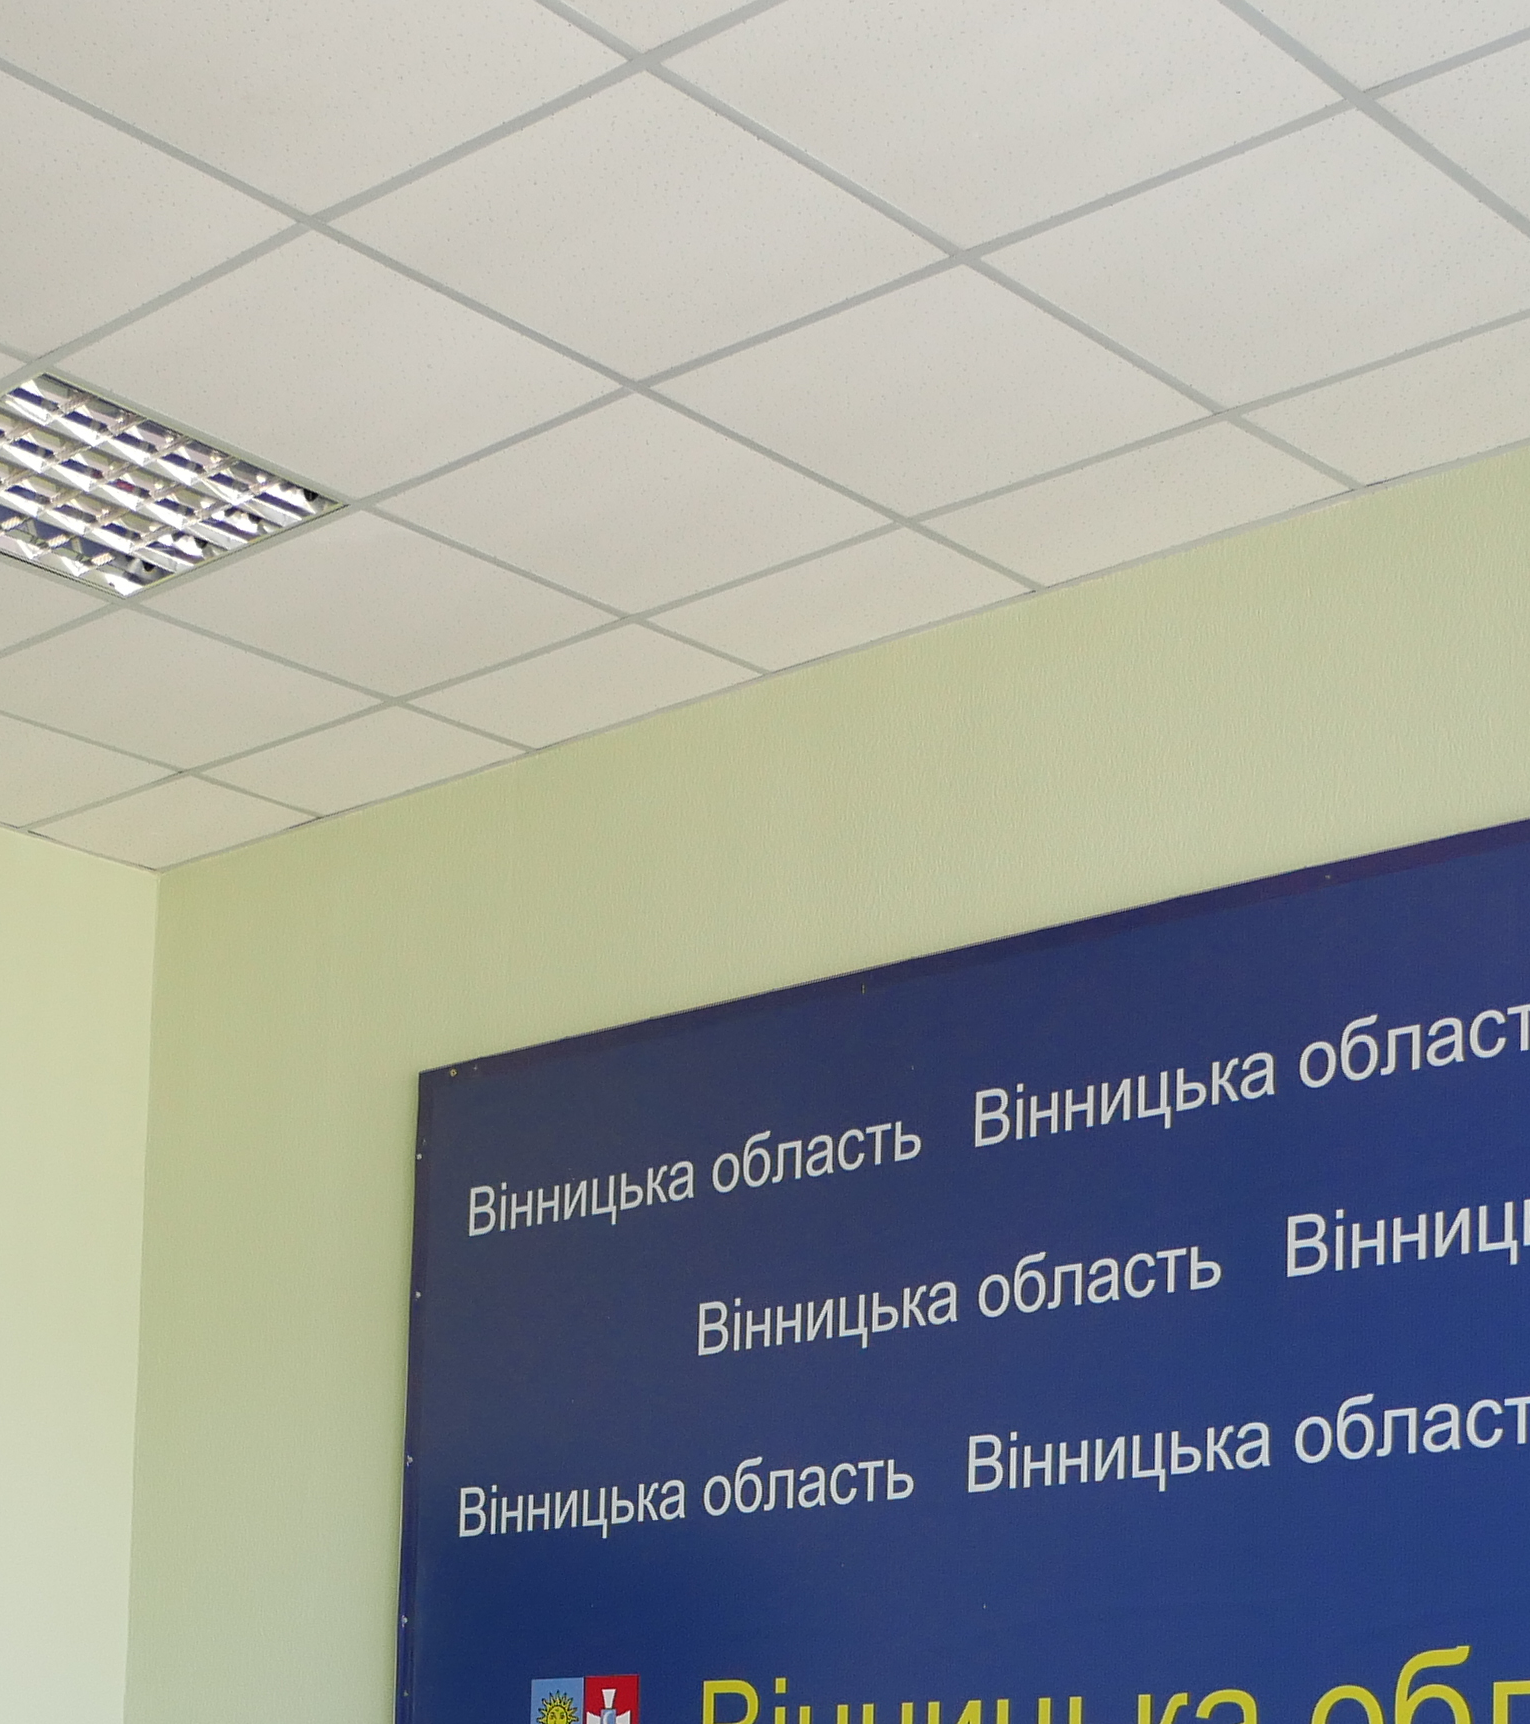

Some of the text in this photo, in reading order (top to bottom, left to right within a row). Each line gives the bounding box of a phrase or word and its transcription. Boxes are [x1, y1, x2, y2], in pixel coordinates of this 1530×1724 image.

[974, 1051, 1276, 1148] Вінницька
[468, 1120, 922, 1237] Вінницька область
[697, 1245, 1222, 1357] Вінницька область
[458, 1455, 915, 1539] Вінницька область
[967, 1421, 1271, 1493] Вінницька
